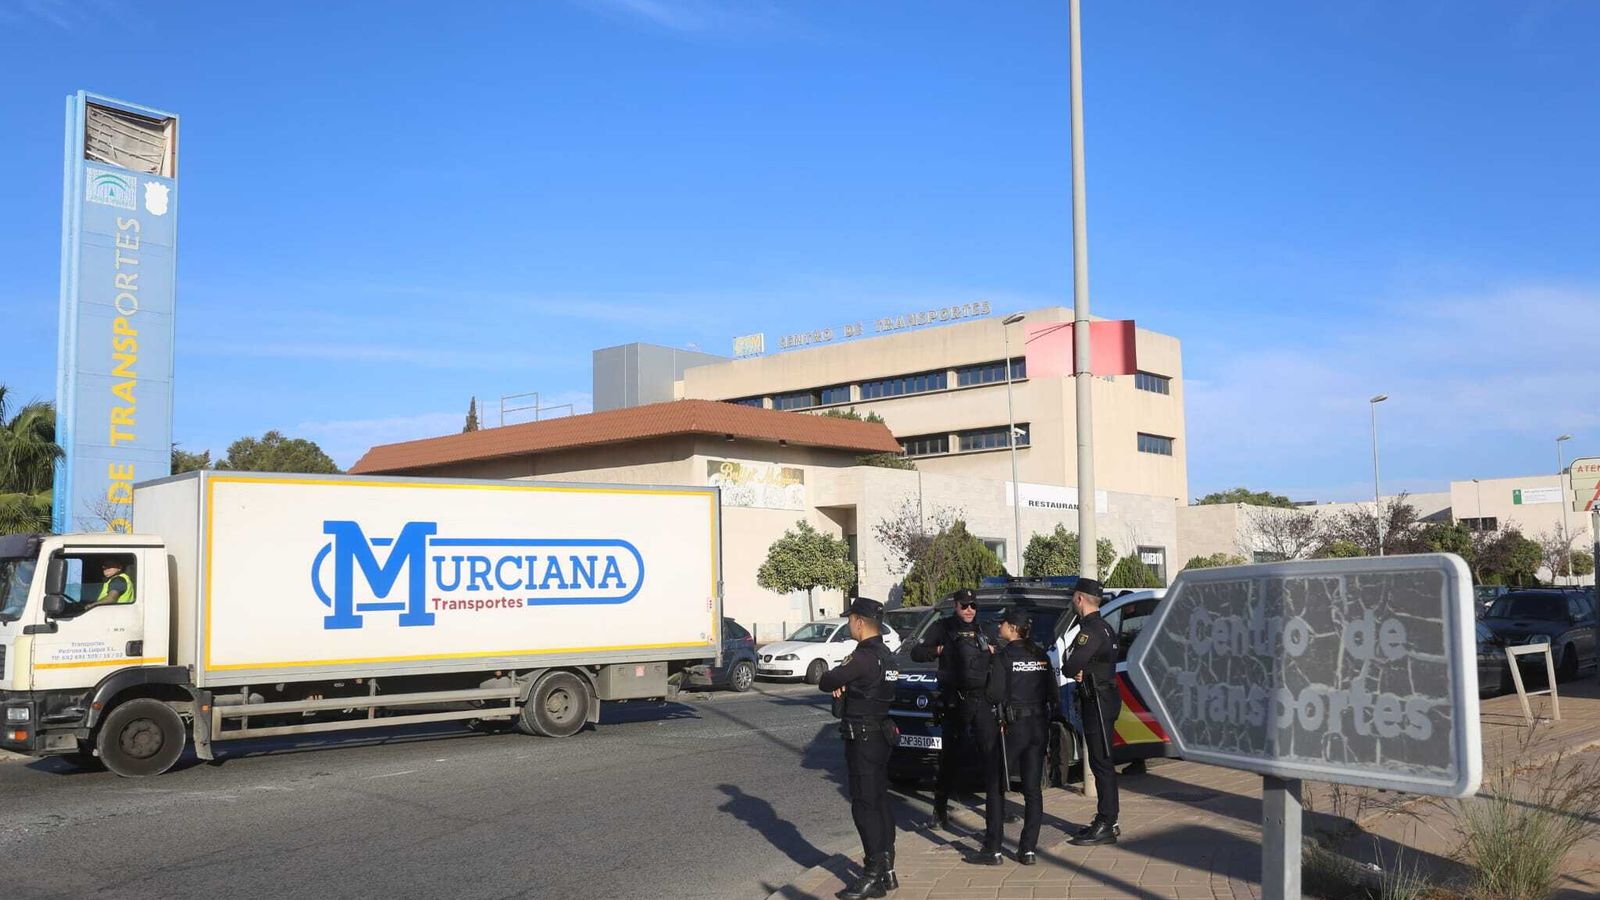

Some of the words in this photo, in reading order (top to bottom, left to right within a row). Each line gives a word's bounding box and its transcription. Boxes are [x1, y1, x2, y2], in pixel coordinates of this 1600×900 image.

[110, 216, 142, 448] TRANSPORTES
[875, 300, 991, 333] TRANSPORTES
[108, 463, 134, 504] DE
[1028, 500, 1080, 510] RESTAURAN
[323, 520, 627, 630] MURCIANA
[432, 597, 524, 612] Transportes
[1189, 606, 1310, 658] Centro
[1343, 608, 1408, 662] de
[897, 674, 938, 683] POL
[1177, 670, 1433, 744] Transportes
